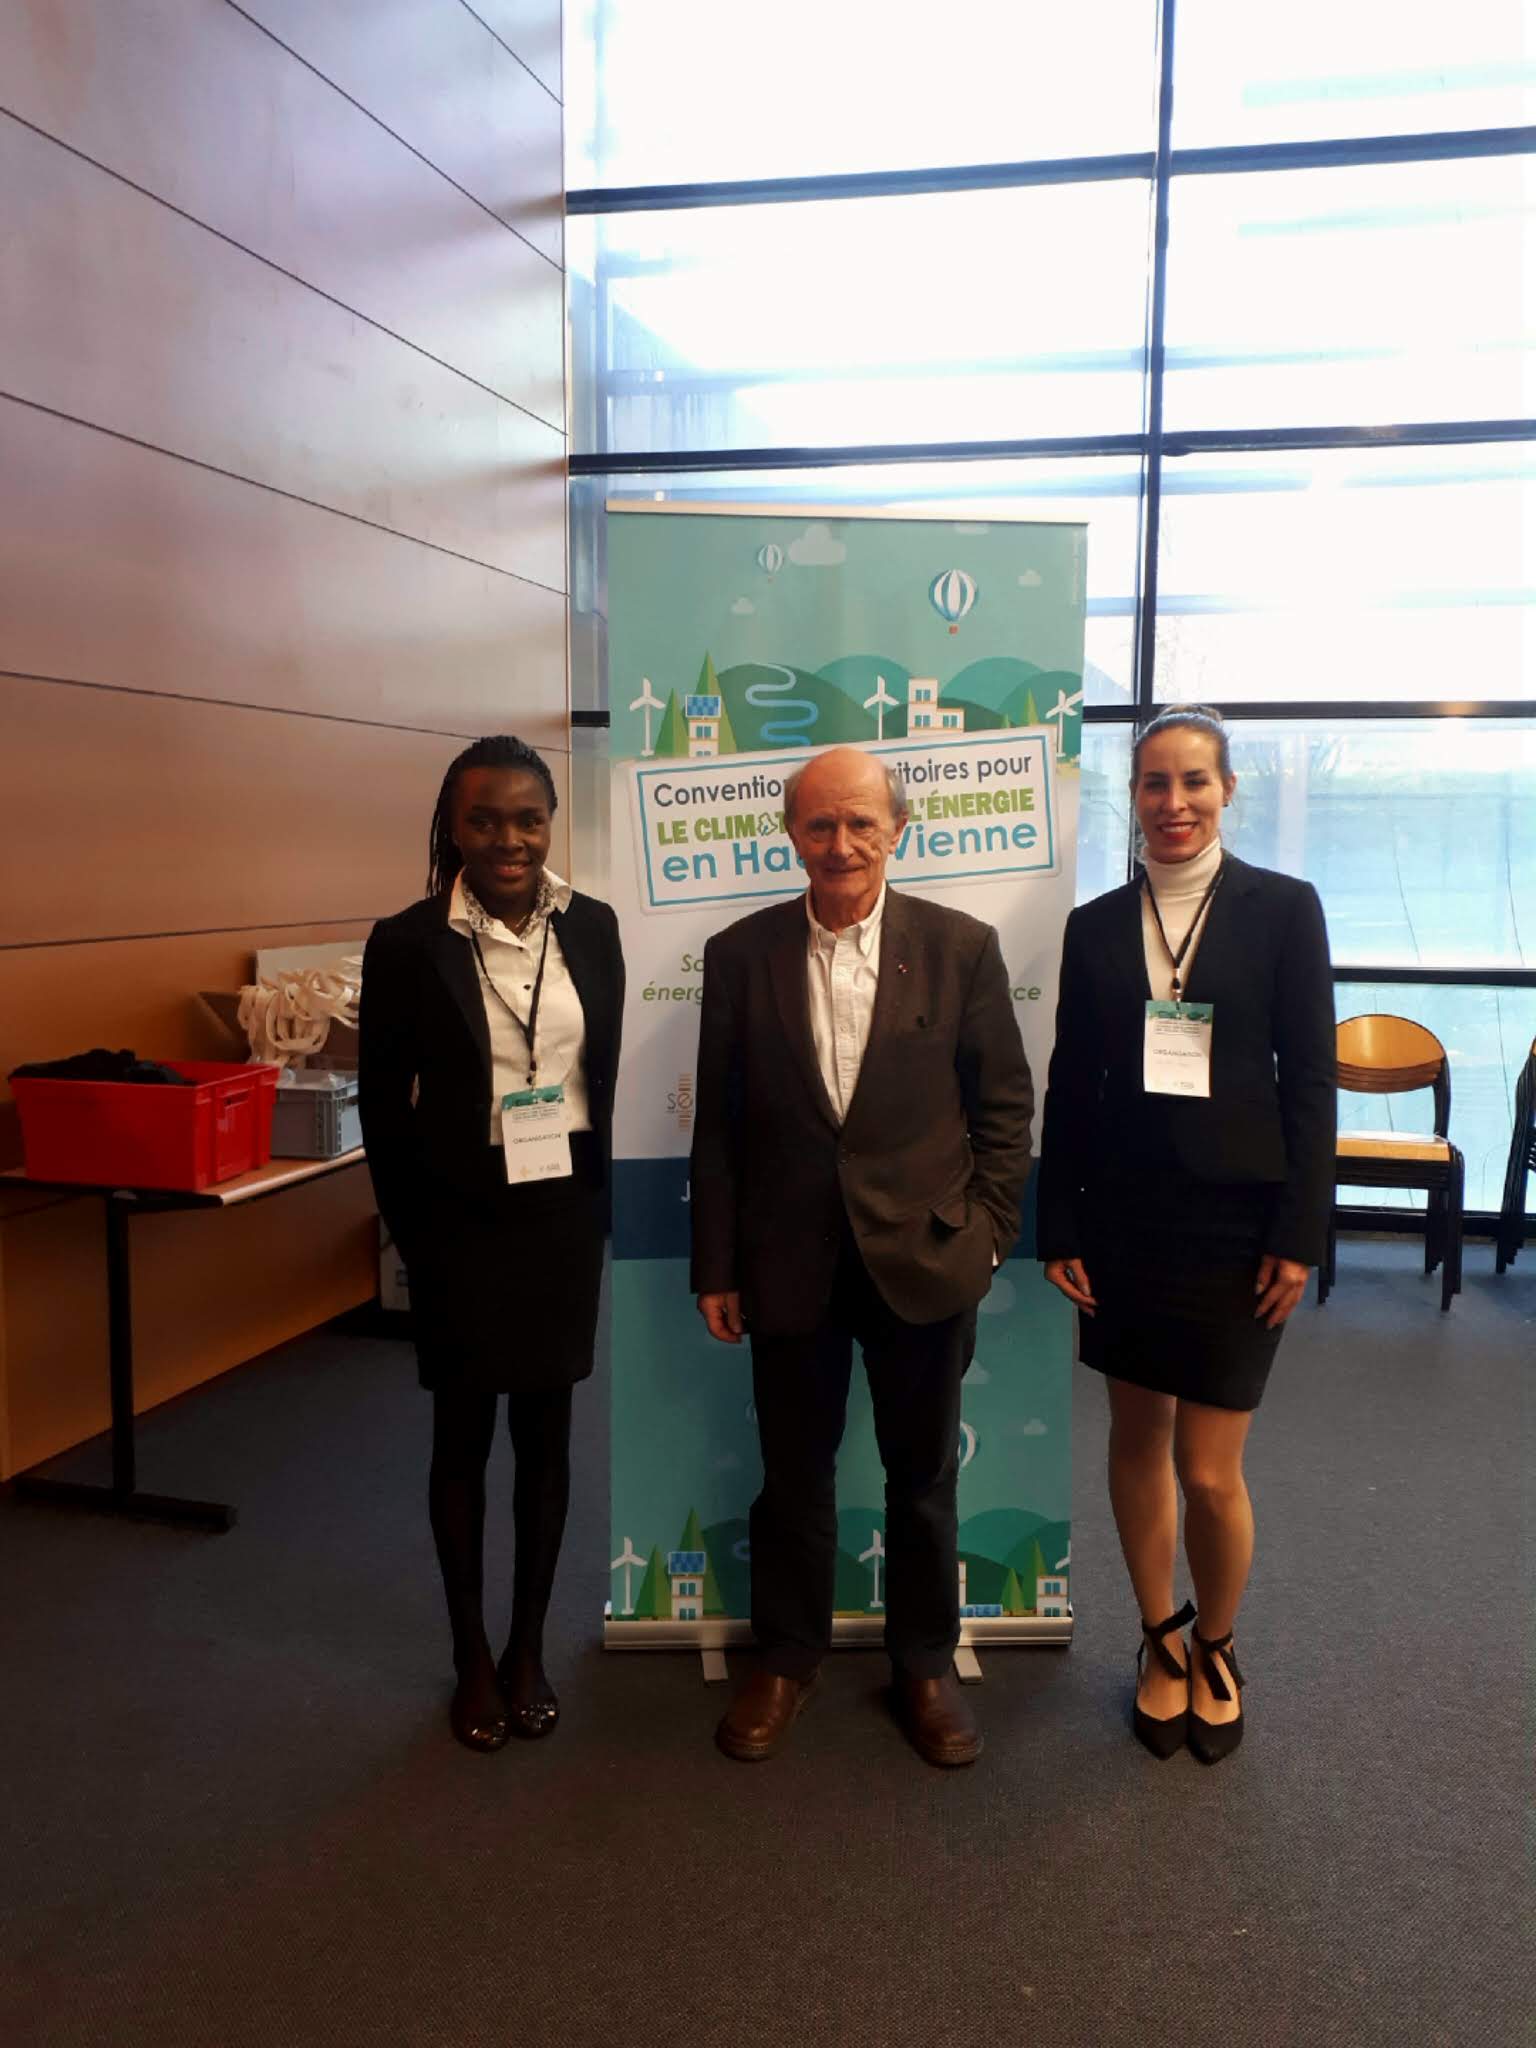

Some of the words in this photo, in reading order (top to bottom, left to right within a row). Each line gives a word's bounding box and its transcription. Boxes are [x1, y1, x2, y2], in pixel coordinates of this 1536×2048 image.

[654, 775, 787, 807] Conventio
[977, 756, 1032, 783] pour
[657, 820, 689, 846] LE
[694, 811, 785, 842] CLIMT
[908, 787, 1035, 822] L'ÉNERGIE
[662, 852, 717, 882] en
[1009, 986, 1042, 1001] ce
